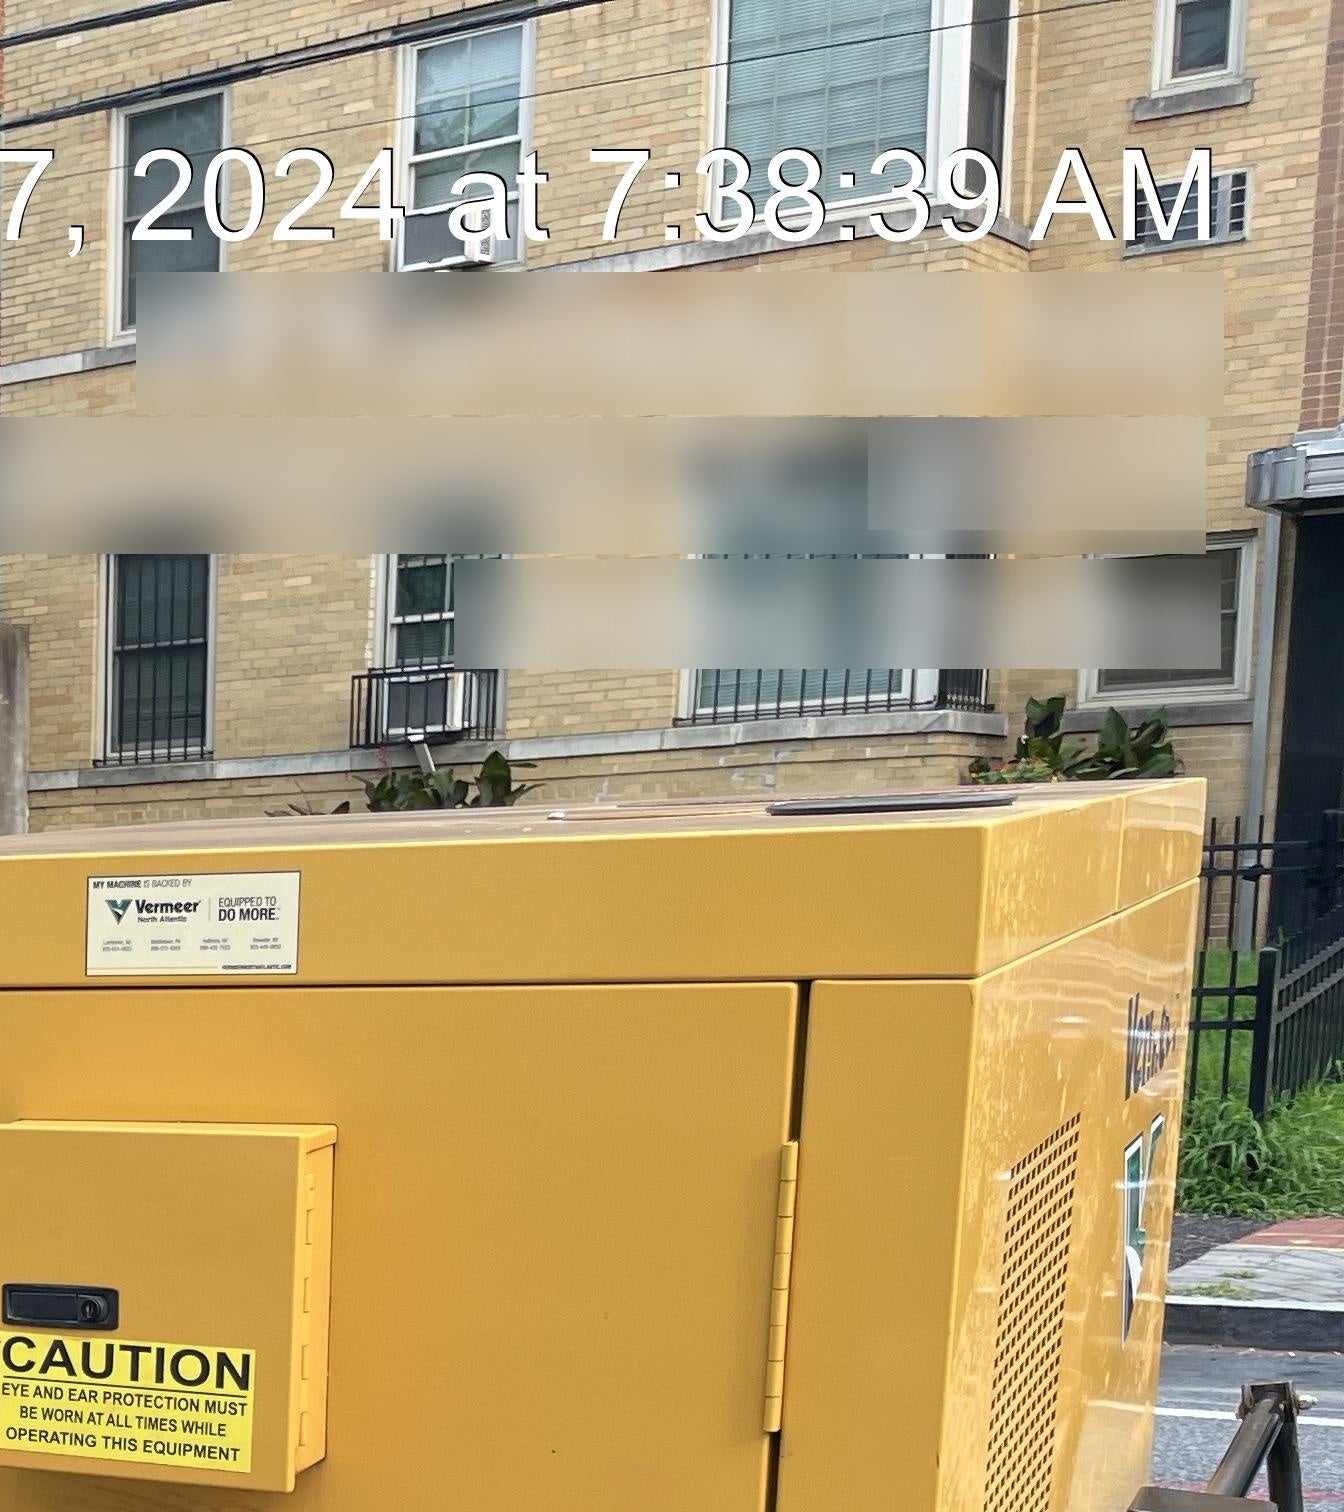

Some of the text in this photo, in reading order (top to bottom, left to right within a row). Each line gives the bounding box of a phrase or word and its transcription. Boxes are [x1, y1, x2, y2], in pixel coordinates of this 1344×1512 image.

[93, 881, 105, 889] MY
[106, 880, 141, 888] MACHINE
[152, 879, 180, 888] BACKED
[182, 879, 192, 887] BY
[135, 899, 200, 914] Vermeer
[218, 896, 277, 907] EQUIPPED TO
[218, 908, 236, 921] DO
[2, 1336, 251, 1391] CAUTION
[1, 1382, 248, 1417] EYE AND EAR PROTECTION MUST
[19, 1405, 227, 1437] BE WORN AT ALL TIMES WHILE
[5, 1427, 240, 1462] OPERATING THIS EQUIPMENT
